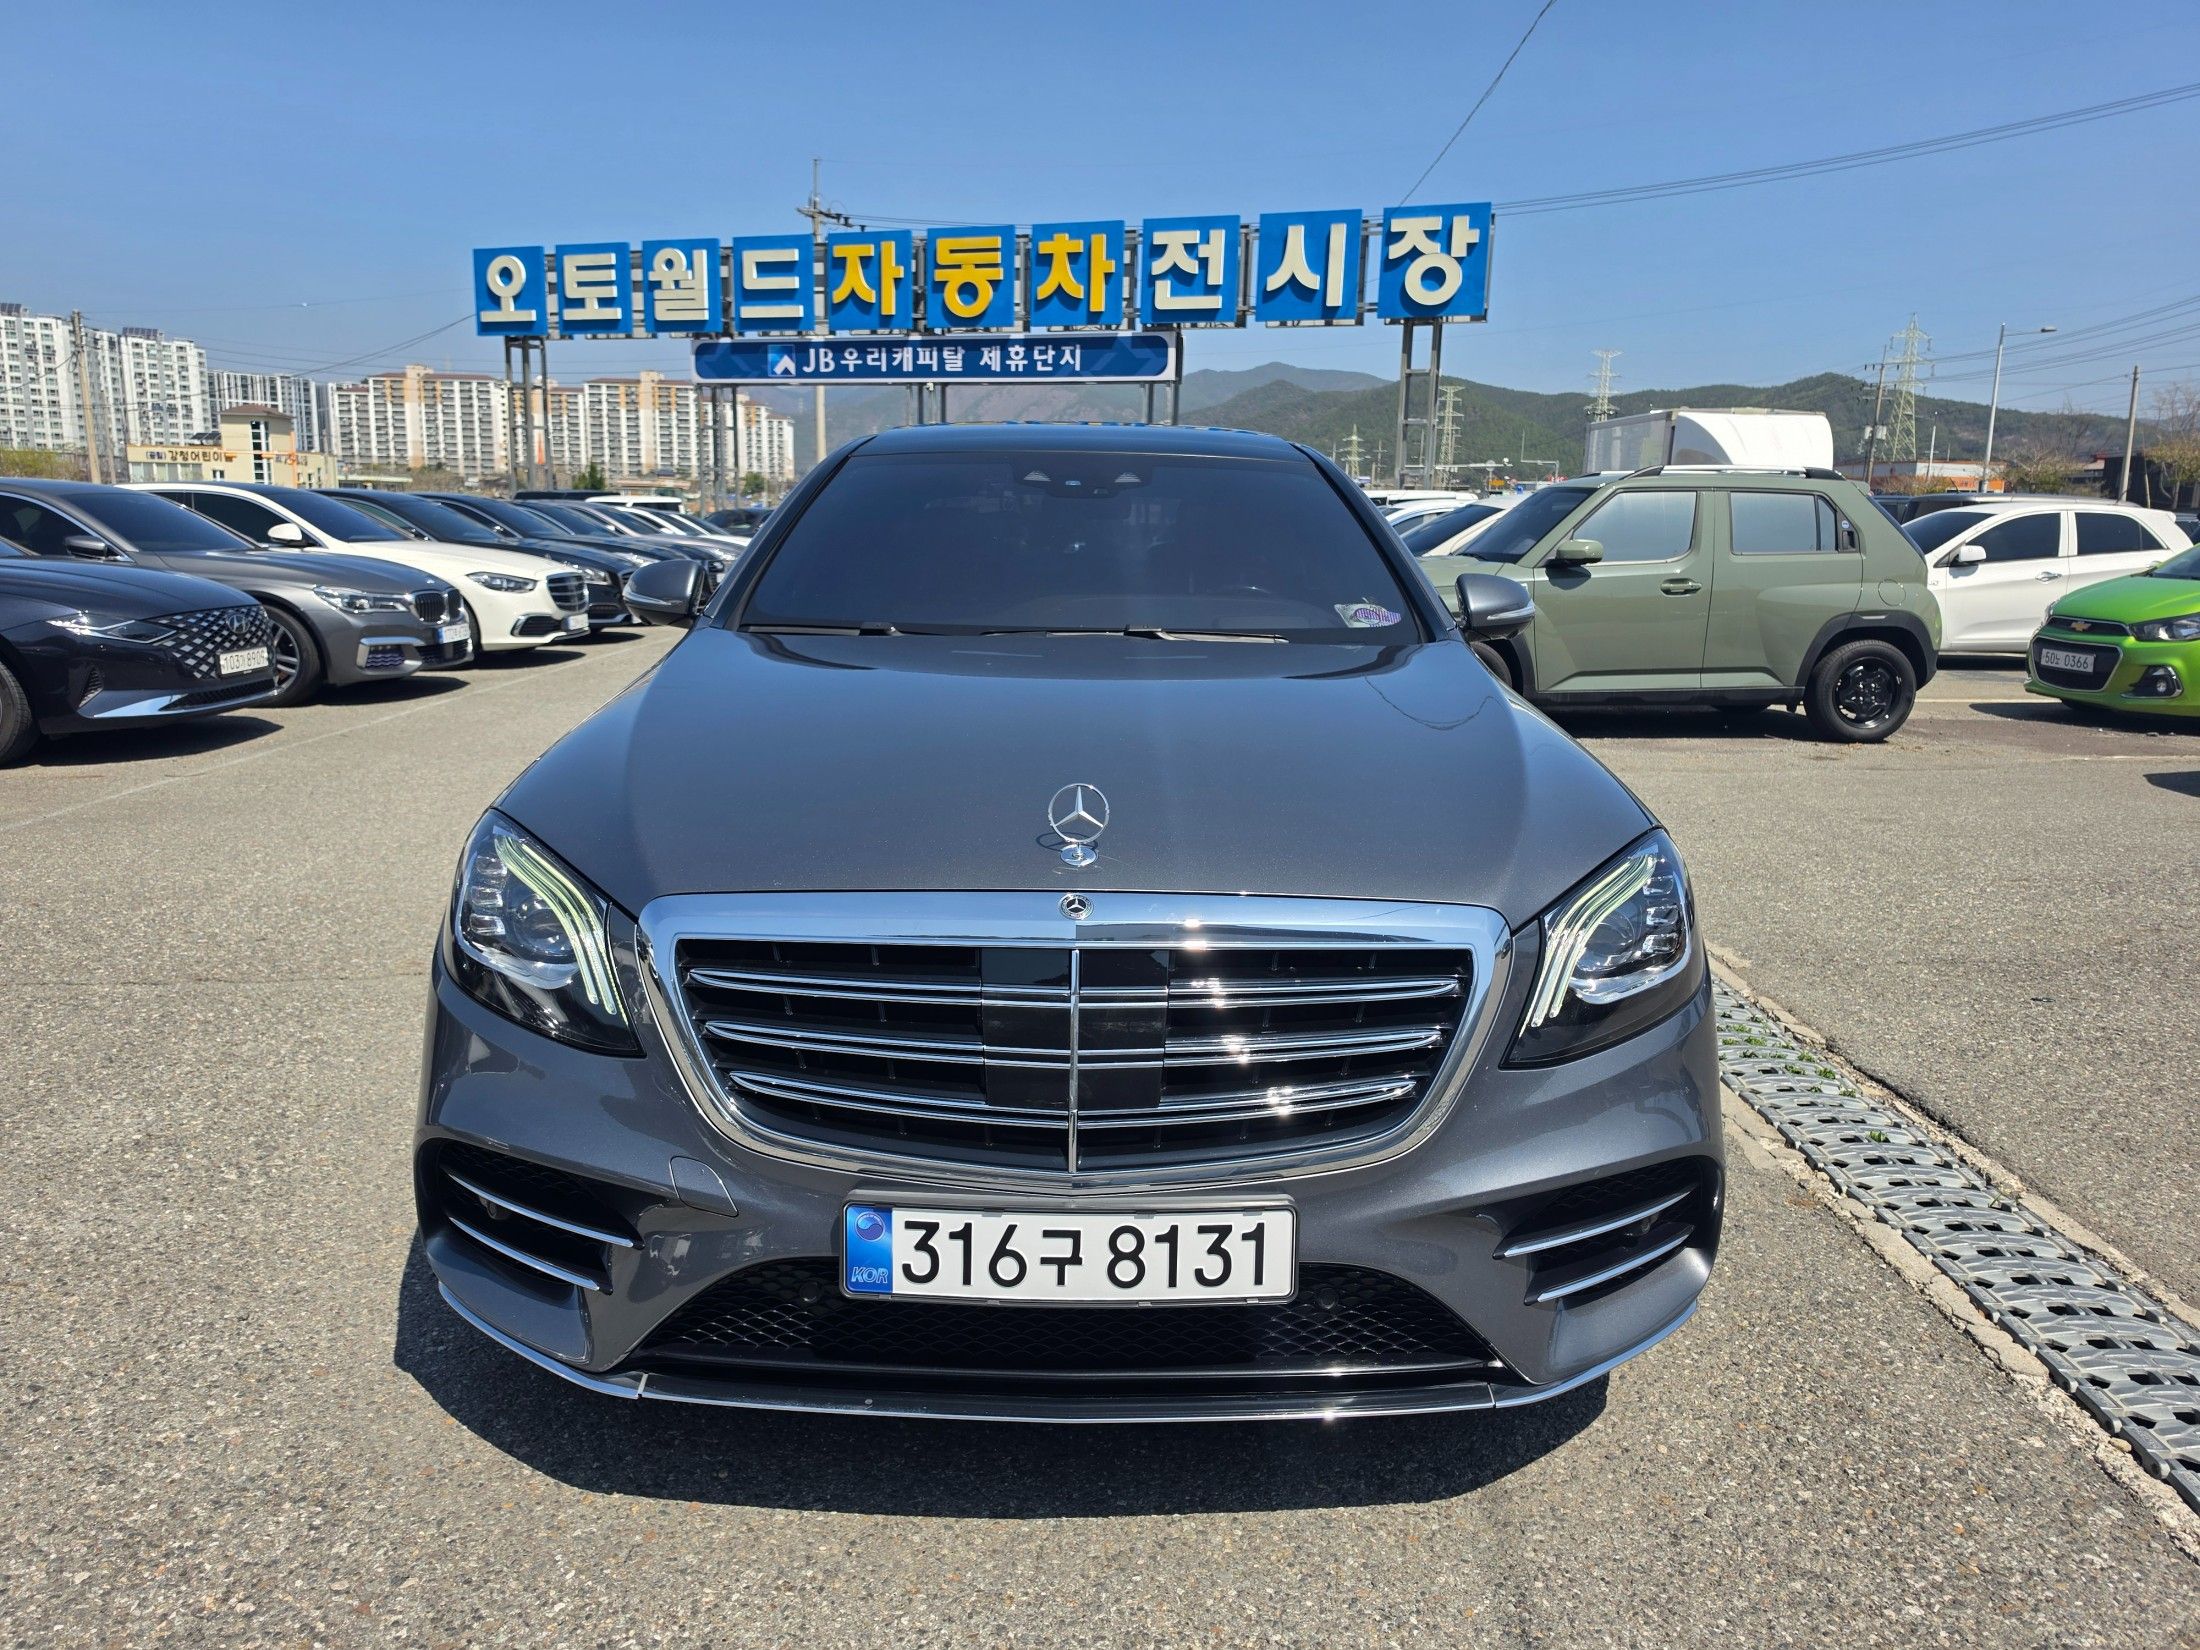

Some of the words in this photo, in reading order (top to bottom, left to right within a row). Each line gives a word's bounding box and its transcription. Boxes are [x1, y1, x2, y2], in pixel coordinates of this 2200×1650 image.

[802, 345, 966, 374] JB우리캐피탈
[979, 344, 1082, 373] 제휴단지
[2045, 651, 2061, 665] 50노
[2064, 654, 2089, 669] 0366
[901, 1220, 1083, 1286] 316구
[1106, 1222, 1266, 1289] 8131
[850, 1266, 889, 1285] KOR
